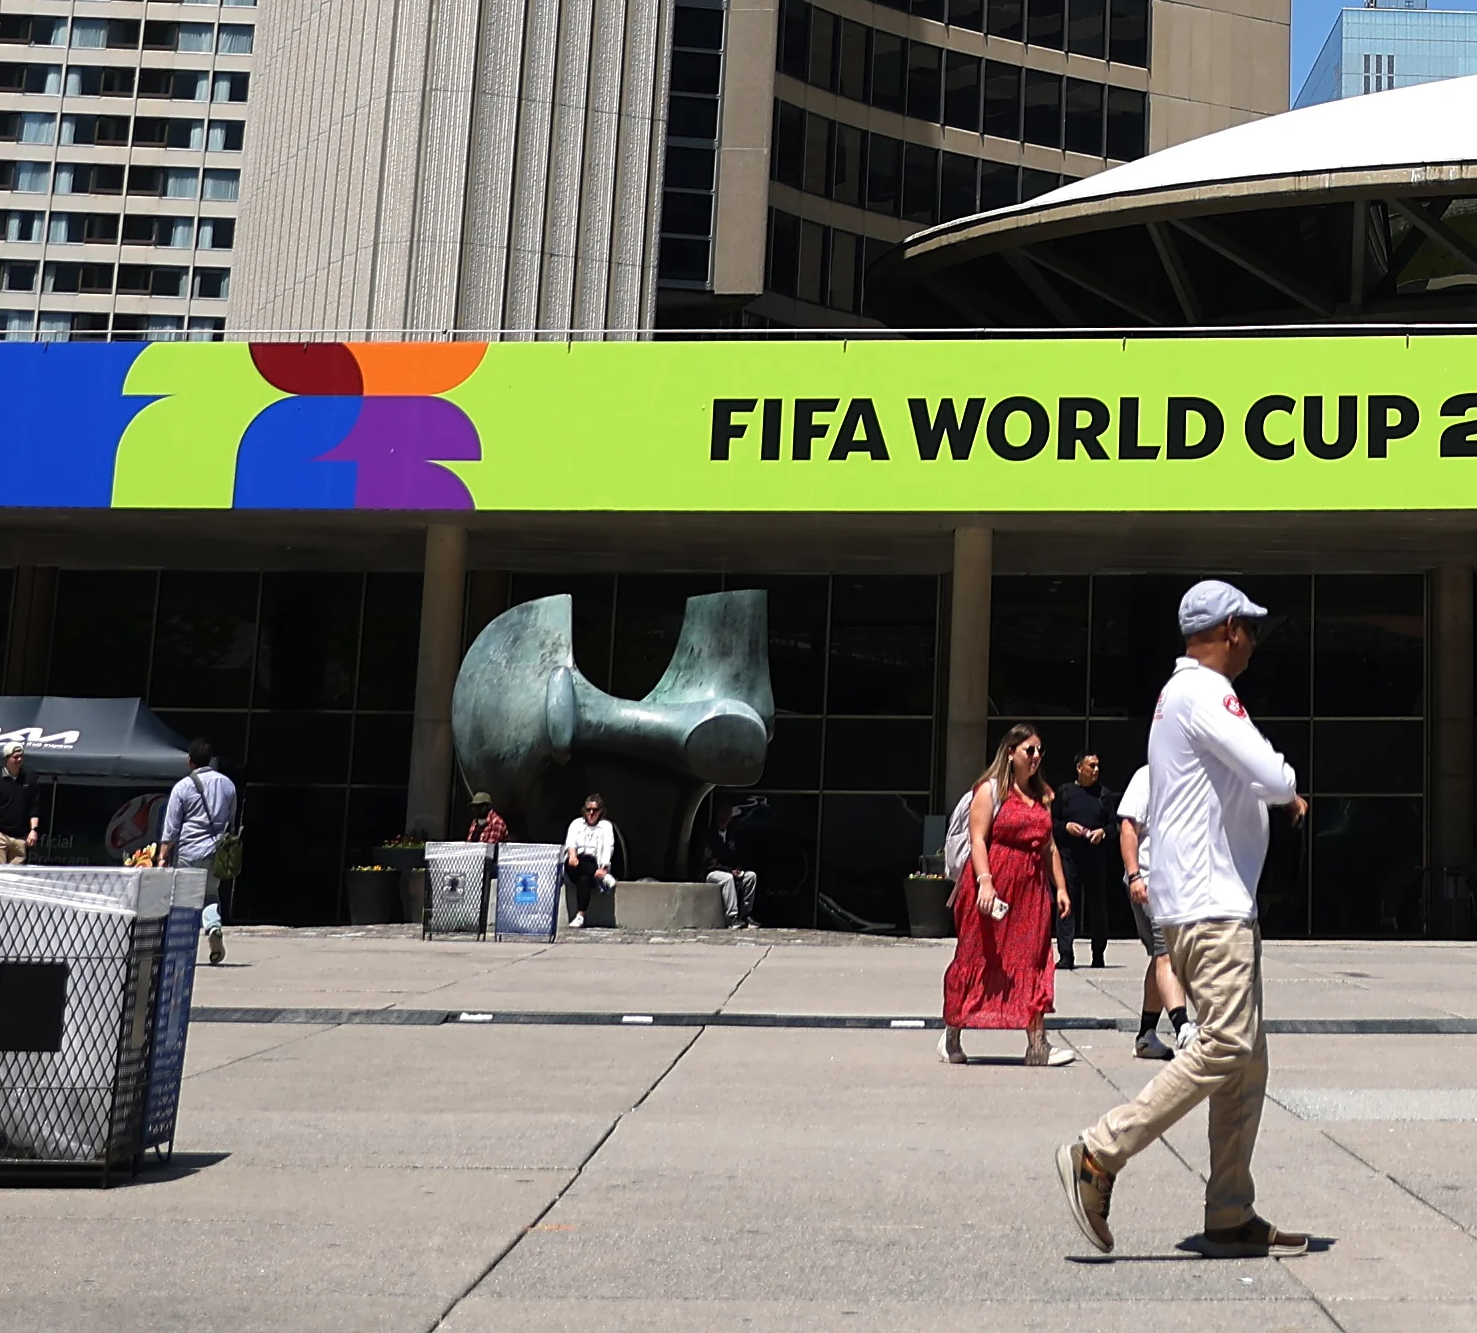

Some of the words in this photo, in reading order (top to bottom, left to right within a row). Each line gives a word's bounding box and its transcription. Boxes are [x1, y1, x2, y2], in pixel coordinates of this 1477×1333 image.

[710, 398, 890, 461] FIFA
[907, 395, 1225, 462] WORLD
[1244, 394, 1420, 461] CUP
